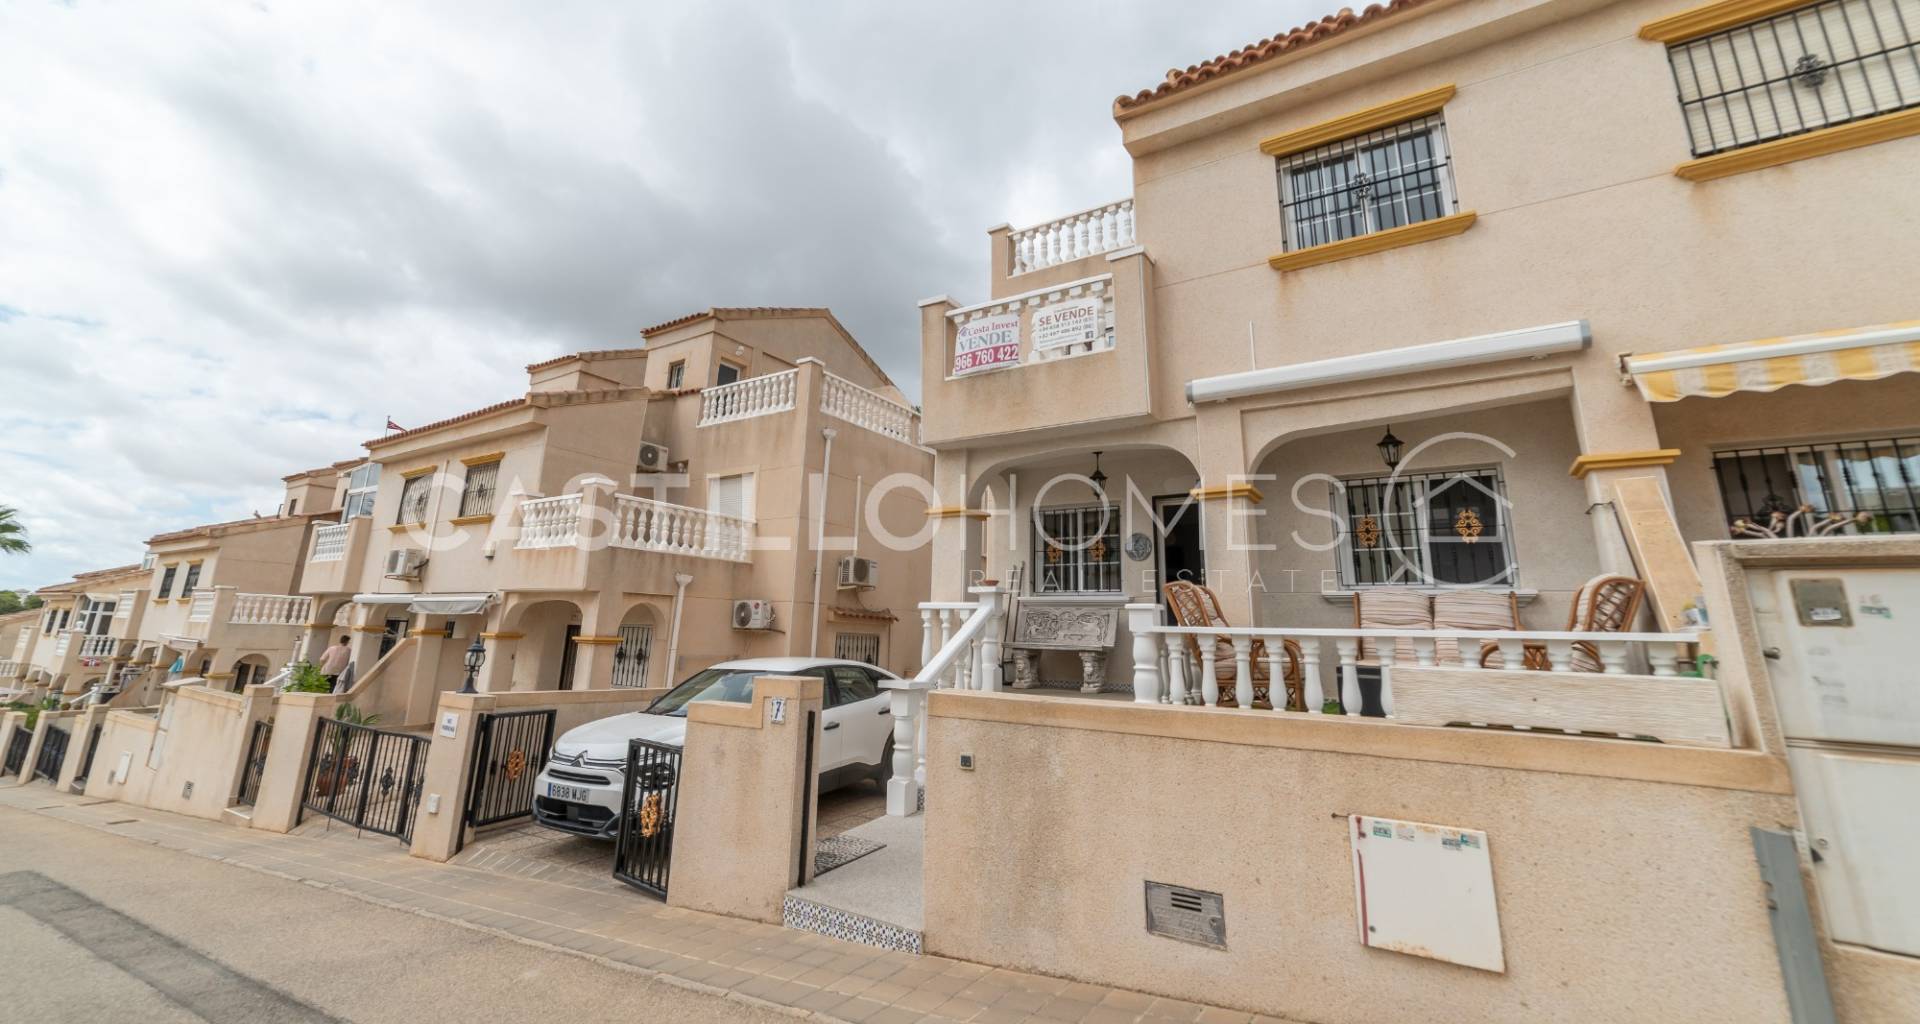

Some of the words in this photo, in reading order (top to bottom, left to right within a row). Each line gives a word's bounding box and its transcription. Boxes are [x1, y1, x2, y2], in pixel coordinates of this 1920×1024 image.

[1039, 315, 1052, 326] SE
[1054, 306, 1094, 322] VENDE
[968, 325, 990, 337] Costa
[992, 320, 1018, 331] Invest
[959, 330, 1012, 352] VENDE
[955, 353, 973, 370] 966
[975, 349, 994, 365] 760
[997, 345, 1018, 361] 422
[774, 701, 782, 720] 7
